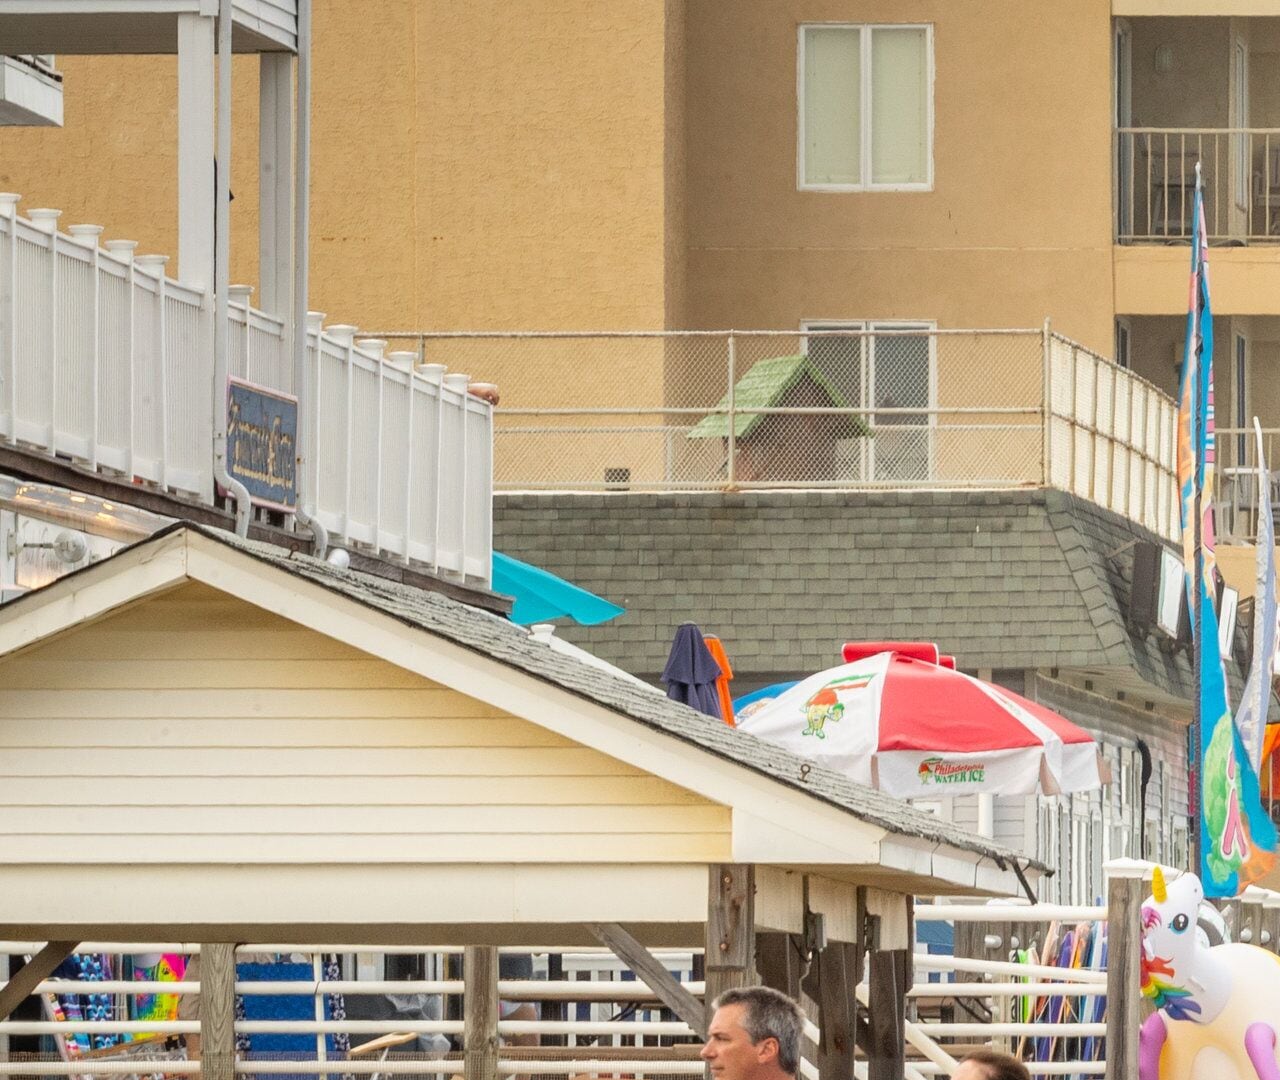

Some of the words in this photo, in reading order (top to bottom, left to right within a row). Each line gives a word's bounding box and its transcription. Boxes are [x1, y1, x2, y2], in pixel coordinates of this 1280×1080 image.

[934, 763, 985, 775] Philadelphia
[934, 771, 967, 783] WATER
[968, 769, 985, 782] ICE
